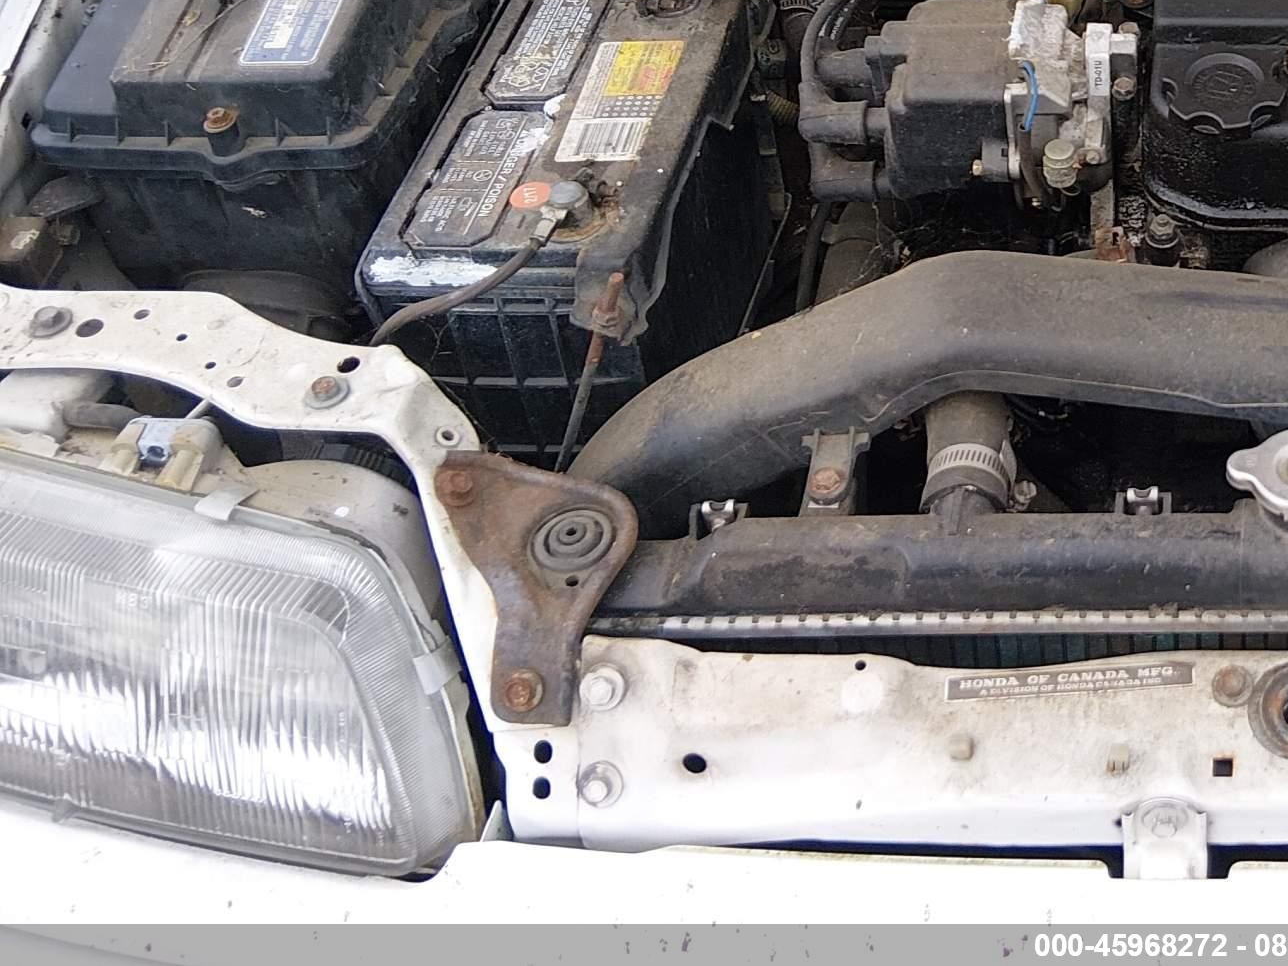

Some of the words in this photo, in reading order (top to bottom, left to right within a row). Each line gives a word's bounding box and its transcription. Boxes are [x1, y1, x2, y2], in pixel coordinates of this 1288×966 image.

[477, 182, 505, 217] POISON
[959, 676, 1020, 690] HONDA
[1027, 674, 1051, 685] OF
[1057, 668, 1129, 684] CANADA
[1056, 680, 1094, 692] HONDA
